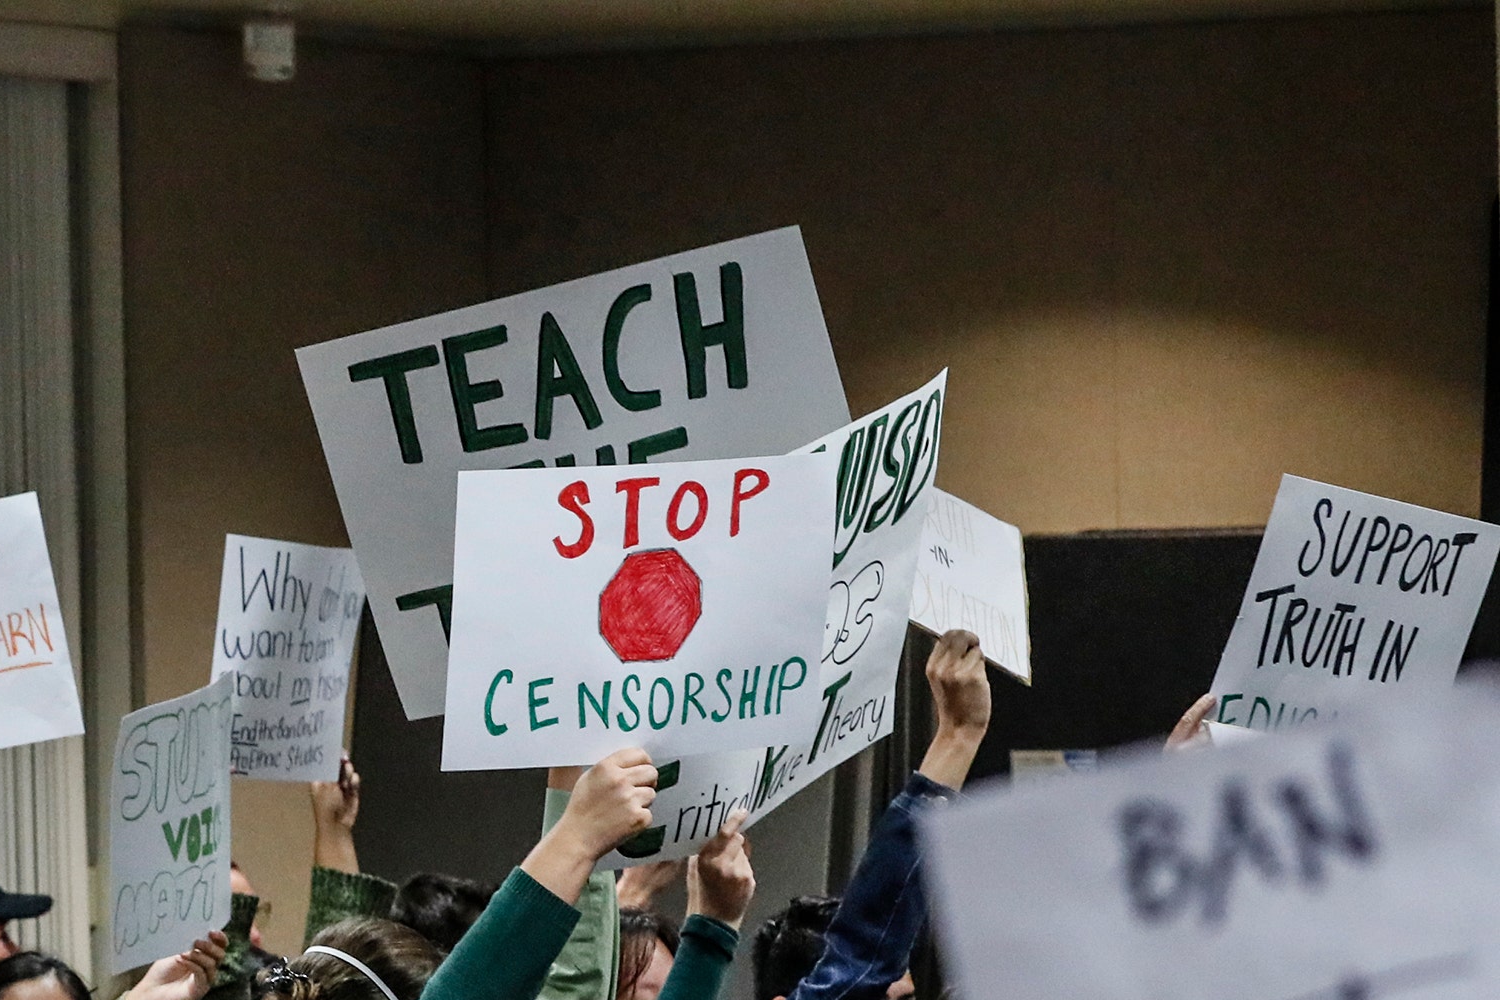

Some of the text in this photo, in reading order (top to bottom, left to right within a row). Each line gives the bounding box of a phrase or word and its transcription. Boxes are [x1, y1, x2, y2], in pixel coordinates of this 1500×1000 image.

[348, 261, 748, 464] TEACH
[553, 468, 770, 559] STOP
[1298, 498, 1479, 597] SUPPORT
[239, 546, 312, 632] Why
[1255, 584, 1420, 683] TRUTH IN
[222, 627, 293, 661] want
[235, 671, 282, 699] bout
[484, 656, 808, 737] CENSORSHIP
[808, 671, 887, 765] Theory
[1118, 742, 1378, 926] BAN
